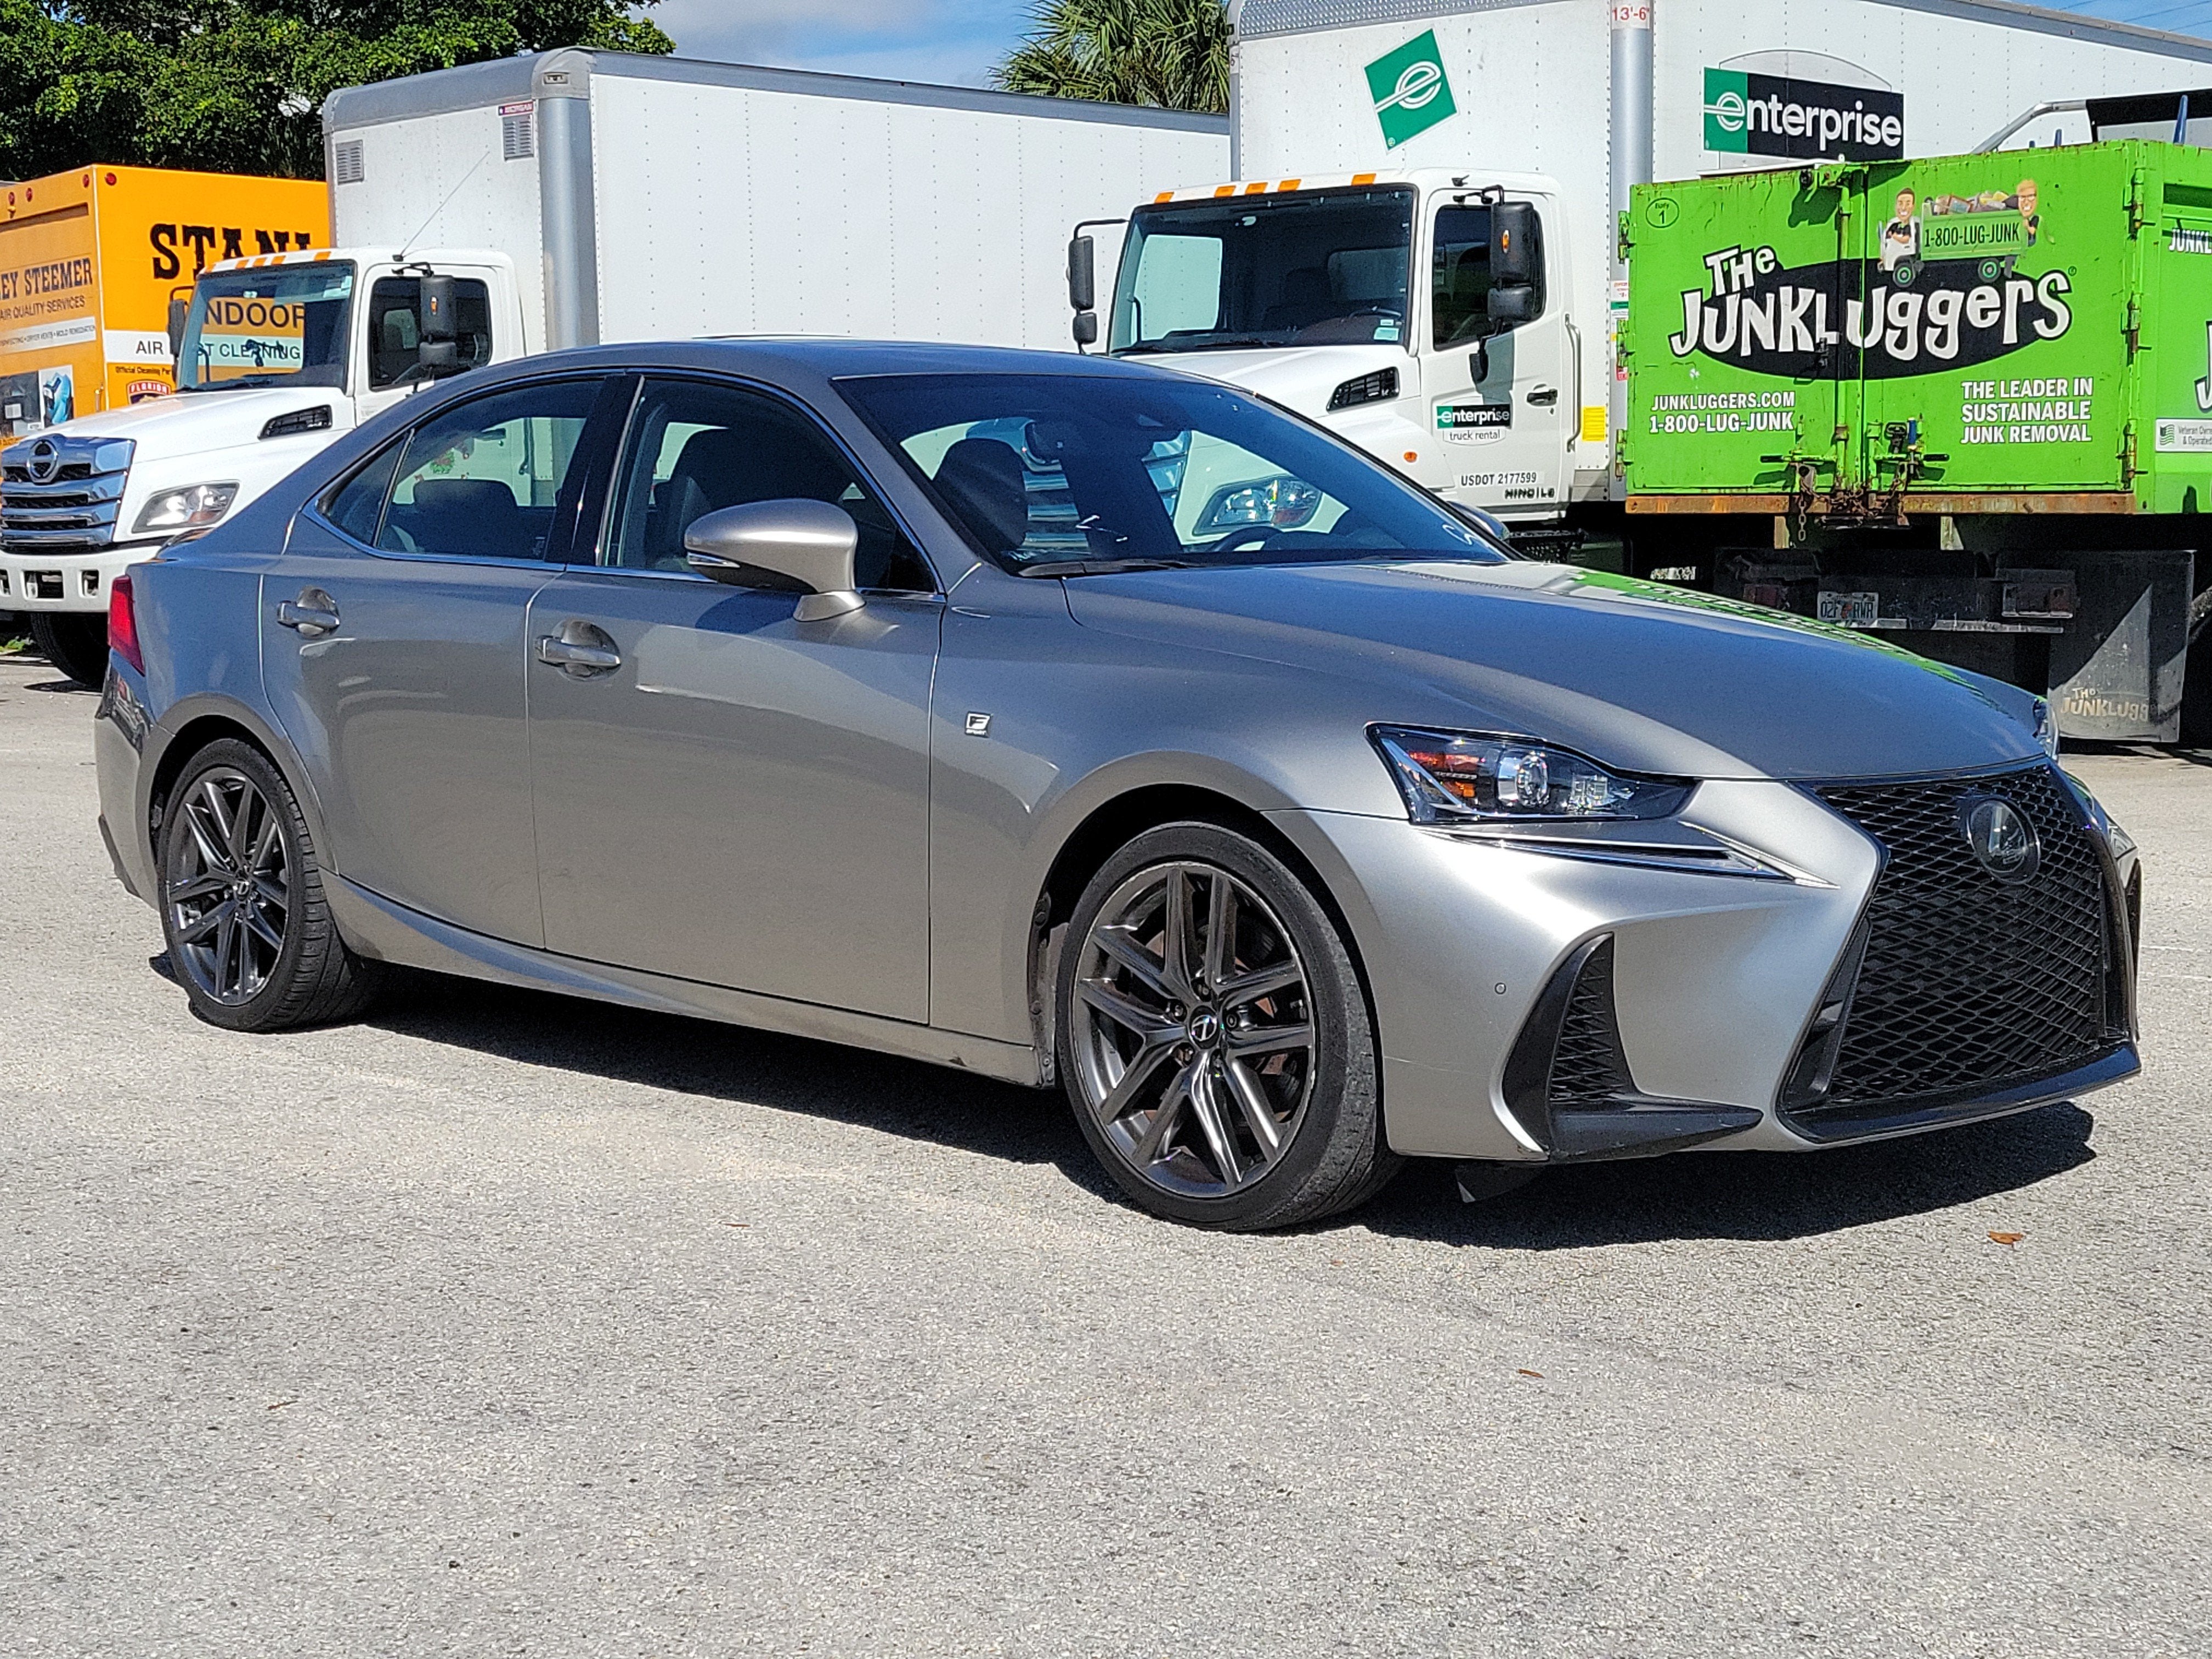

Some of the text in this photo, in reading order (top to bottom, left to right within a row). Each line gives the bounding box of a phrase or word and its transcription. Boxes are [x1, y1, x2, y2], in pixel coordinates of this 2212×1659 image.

[1704, 89, 1903, 151] enterprise
[1658, 210, 1665, 224] 1
[1924, 222, 2020, 247] 1-800-LUG-JUNK
[0, 257, 93, 300] EY STEEMER
[13, 302, 45, 318] QUALITY
[47, 295, 86, 313] SERVICES
[136, 340, 164, 354] AIR
[1961, 376, 2094, 399] THE LEADER IN
[1651, 391, 1796, 411] JUNKLUGGERS.COM
[1961, 400, 2091, 423] SUSTAINABLE
[1437, 407, 1510, 425] enterprise
[1649, 411, 1795, 433] 1-800-LUG-JUNK
[1449, 428, 1500, 441] truck rental
[1960, 424, 2092, 444] JUNK REMOVAL
[1461, 472, 1537, 486] USDOT 2177599
